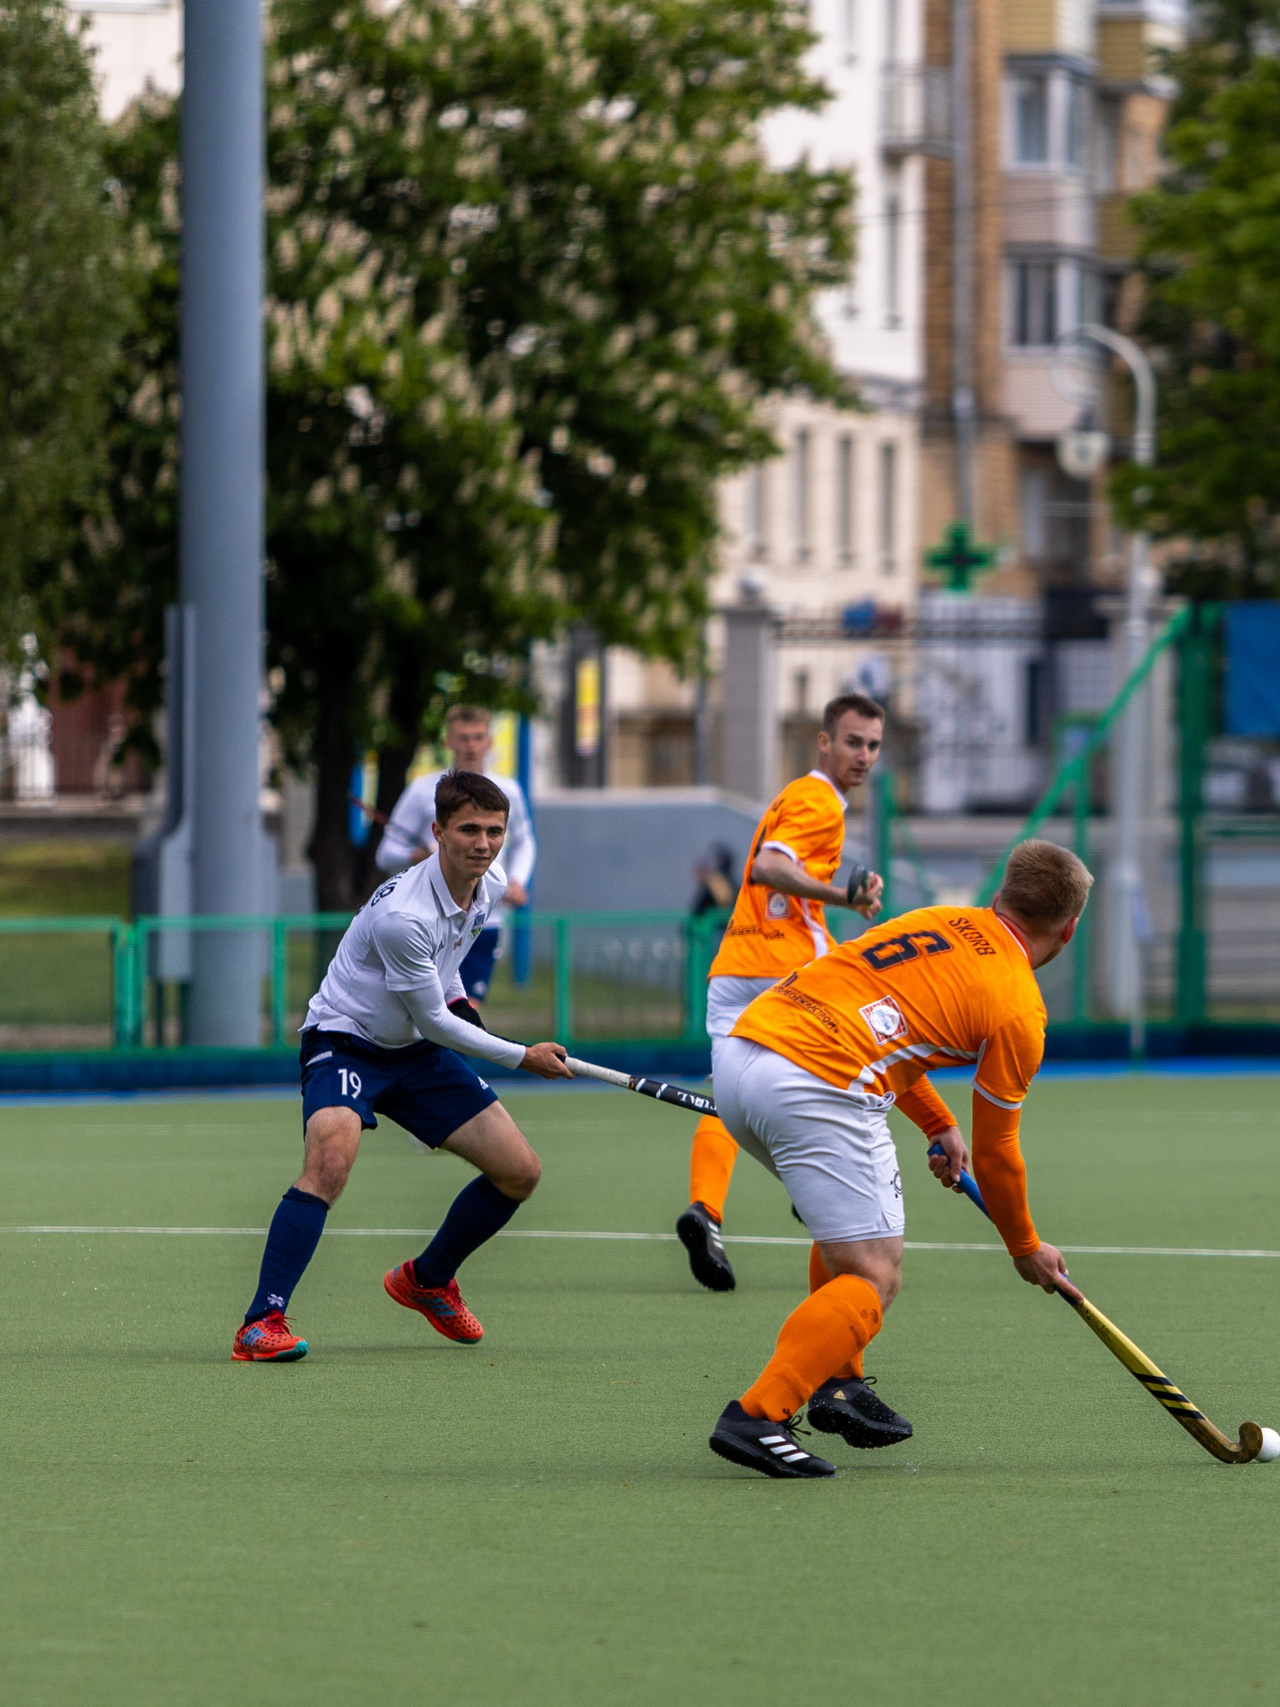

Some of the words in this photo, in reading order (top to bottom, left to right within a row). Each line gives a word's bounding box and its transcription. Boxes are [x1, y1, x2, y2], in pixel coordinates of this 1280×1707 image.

[859, 929, 953, 972] 6
[949, 917, 997, 956] SKORB
[338, 1068, 362, 1100] 19
